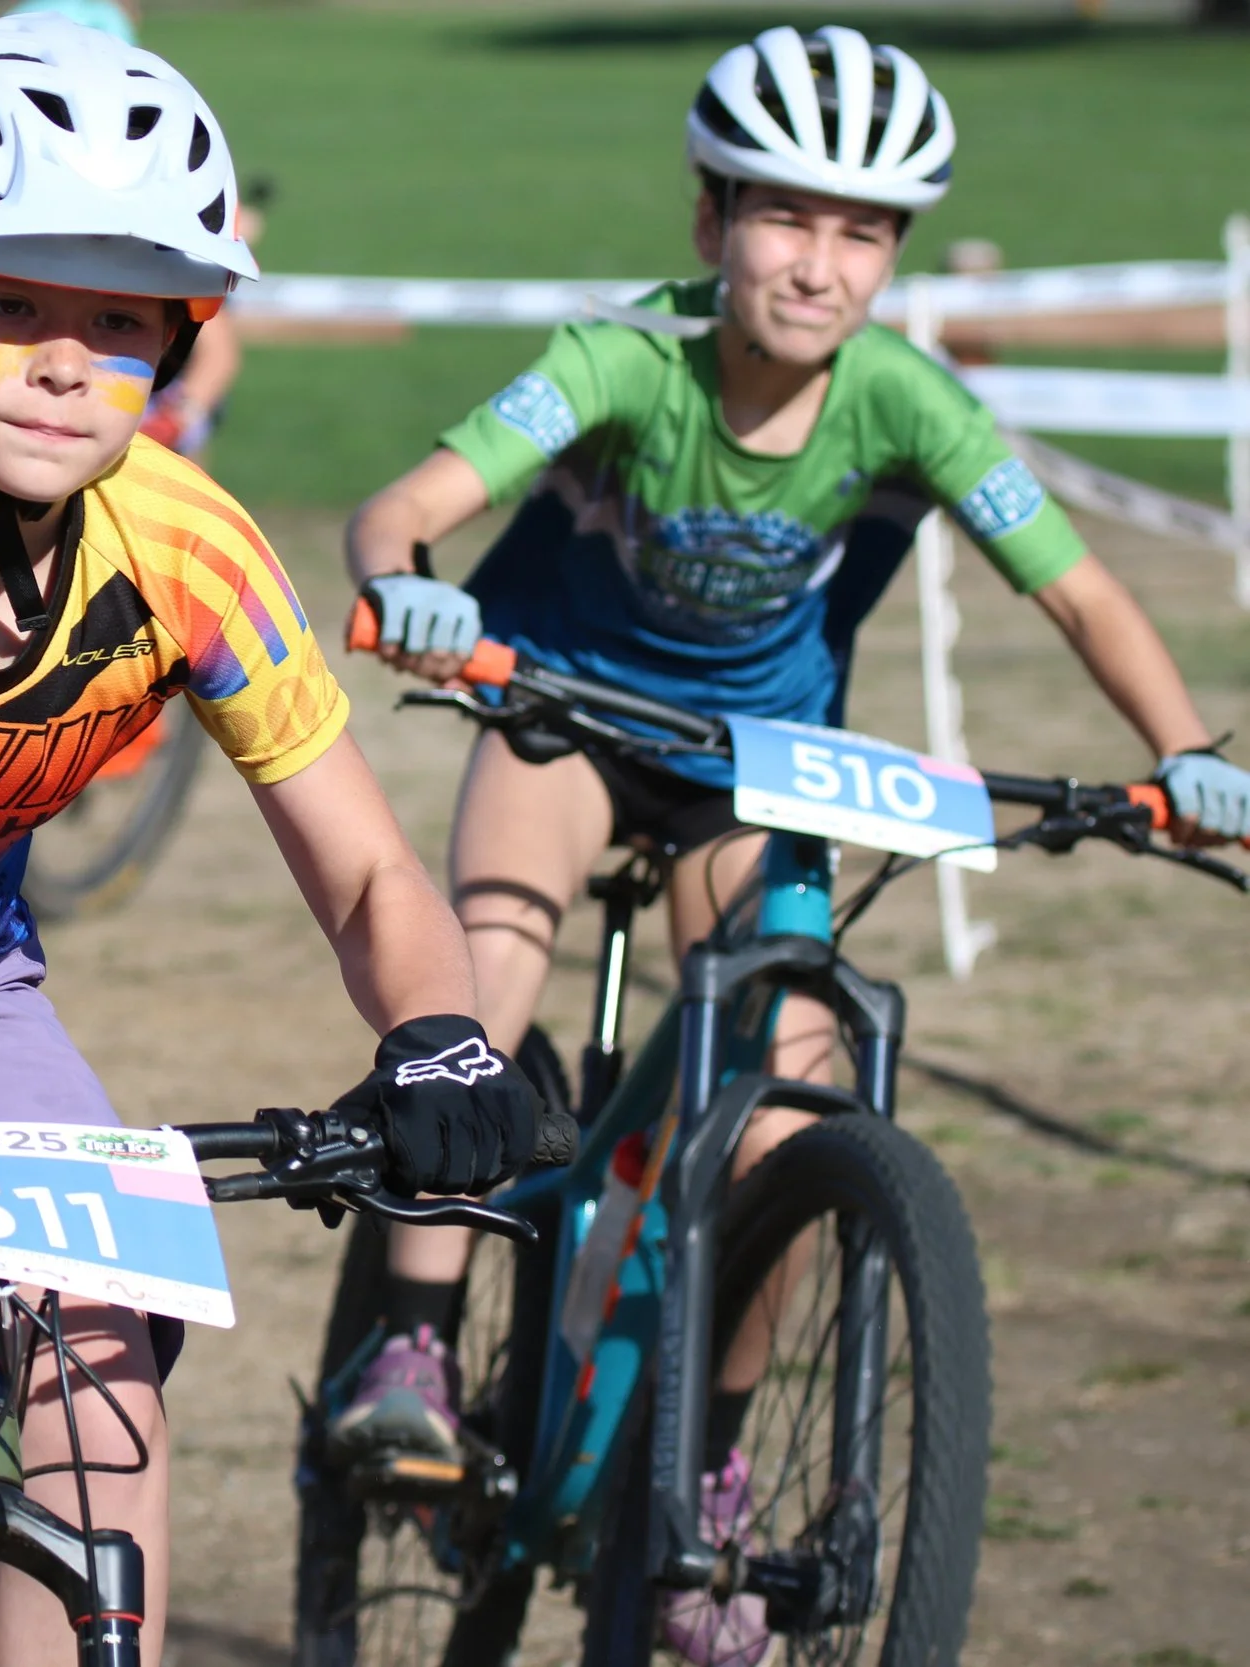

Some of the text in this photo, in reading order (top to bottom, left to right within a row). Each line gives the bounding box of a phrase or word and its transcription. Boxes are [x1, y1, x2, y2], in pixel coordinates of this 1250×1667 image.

[61, 641, 154, 667] VOLER
[791, 740, 938, 821] 510
[82, 1138, 163, 1154] TREE TOP
